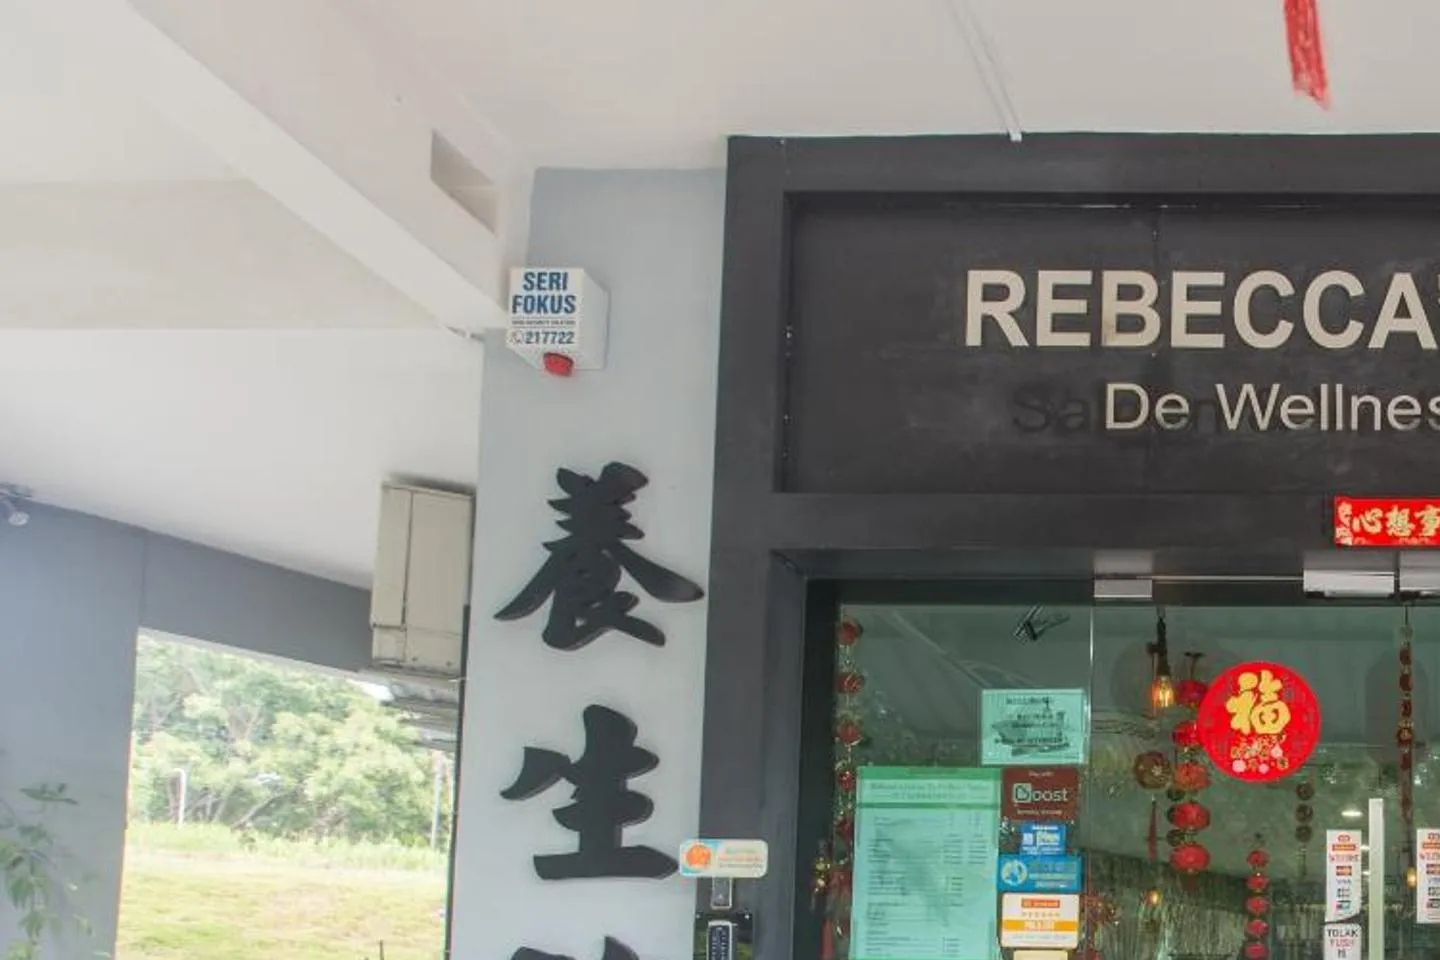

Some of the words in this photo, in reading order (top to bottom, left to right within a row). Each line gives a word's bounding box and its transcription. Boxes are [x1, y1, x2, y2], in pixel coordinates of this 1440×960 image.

[523, 272, 568, 291] SERI
[512, 295, 577, 314] FOKUS
[1104, 383, 1190, 430] De
[1225, 669, 1292, 735] 福
[1327, 928, 1358, 937] TOLAK
